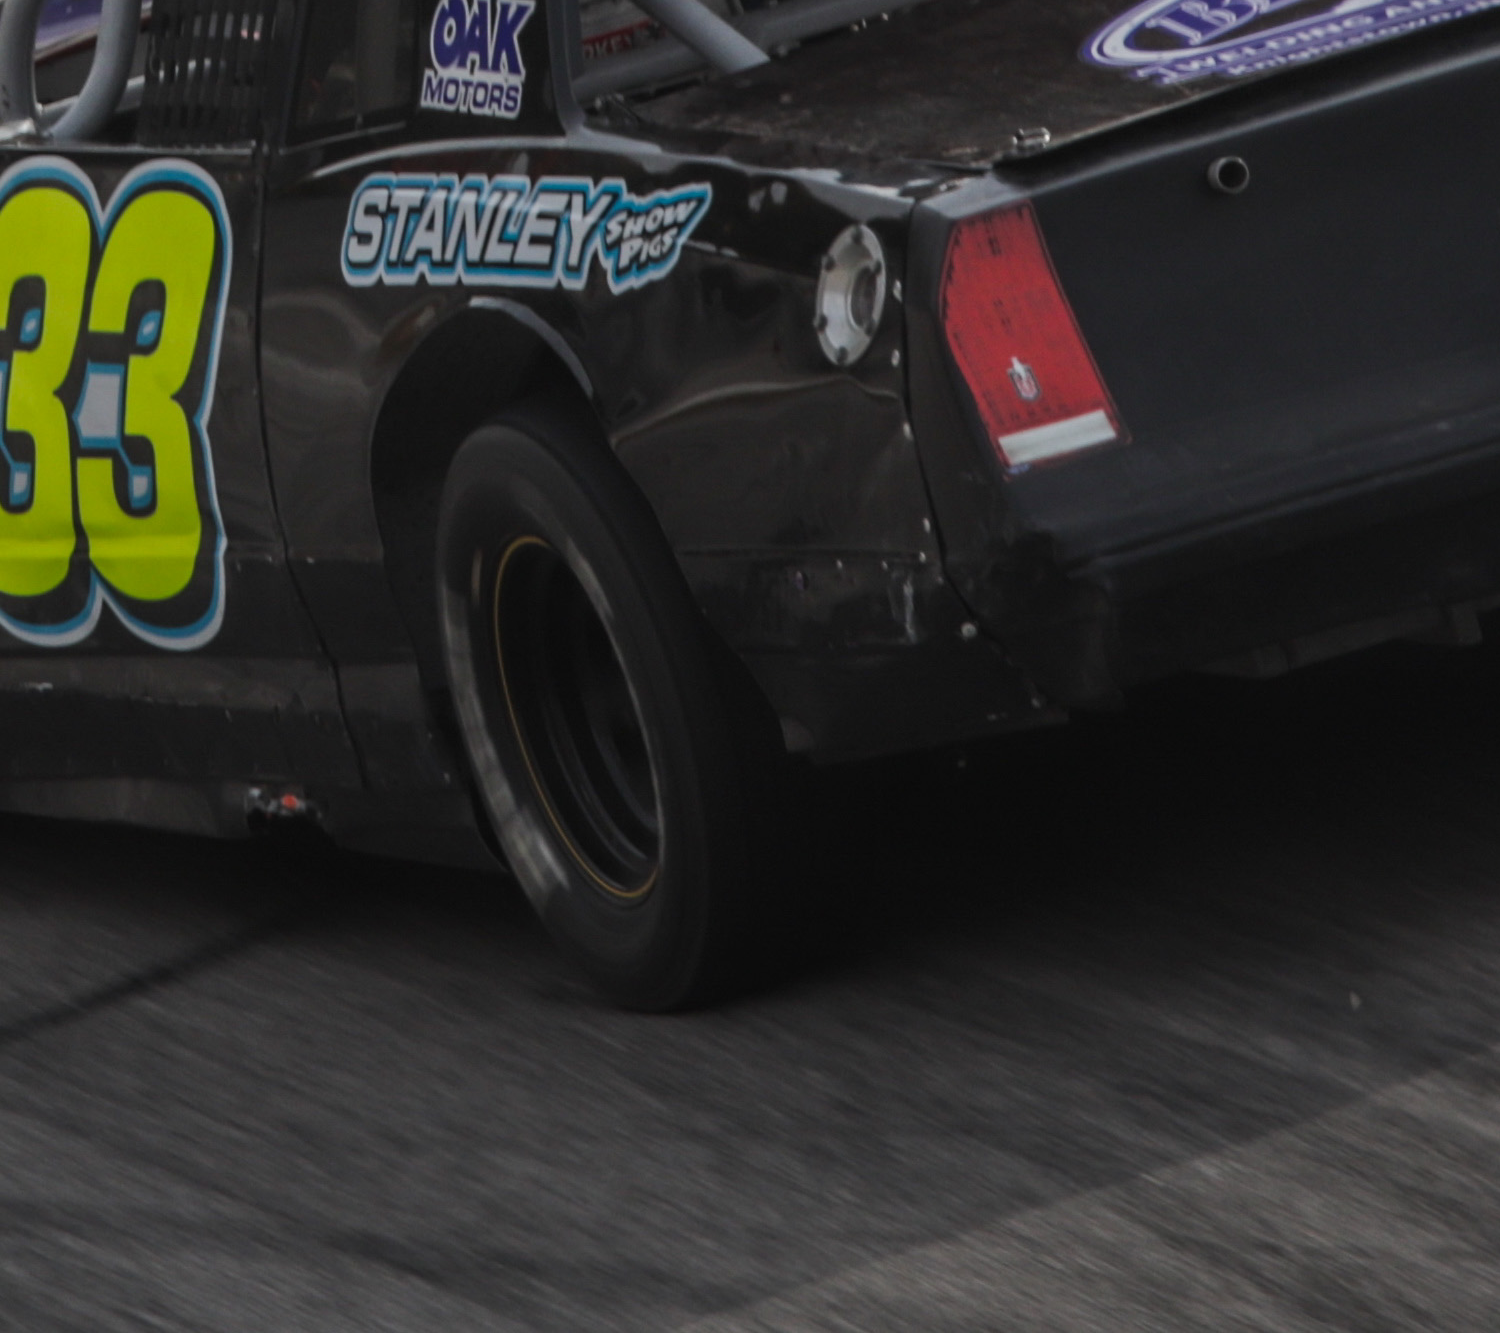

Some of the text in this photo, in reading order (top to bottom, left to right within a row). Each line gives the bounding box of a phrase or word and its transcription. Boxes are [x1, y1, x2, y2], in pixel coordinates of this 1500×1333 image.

[1176, 14, 1374, 72] WELDING
[421, 73, 522, 115] MOTORS
[345, 184, 613, 272] STANLEY
[605, 199, 698, 250] SHOW
[618, 227, 681, 271] PIGS
